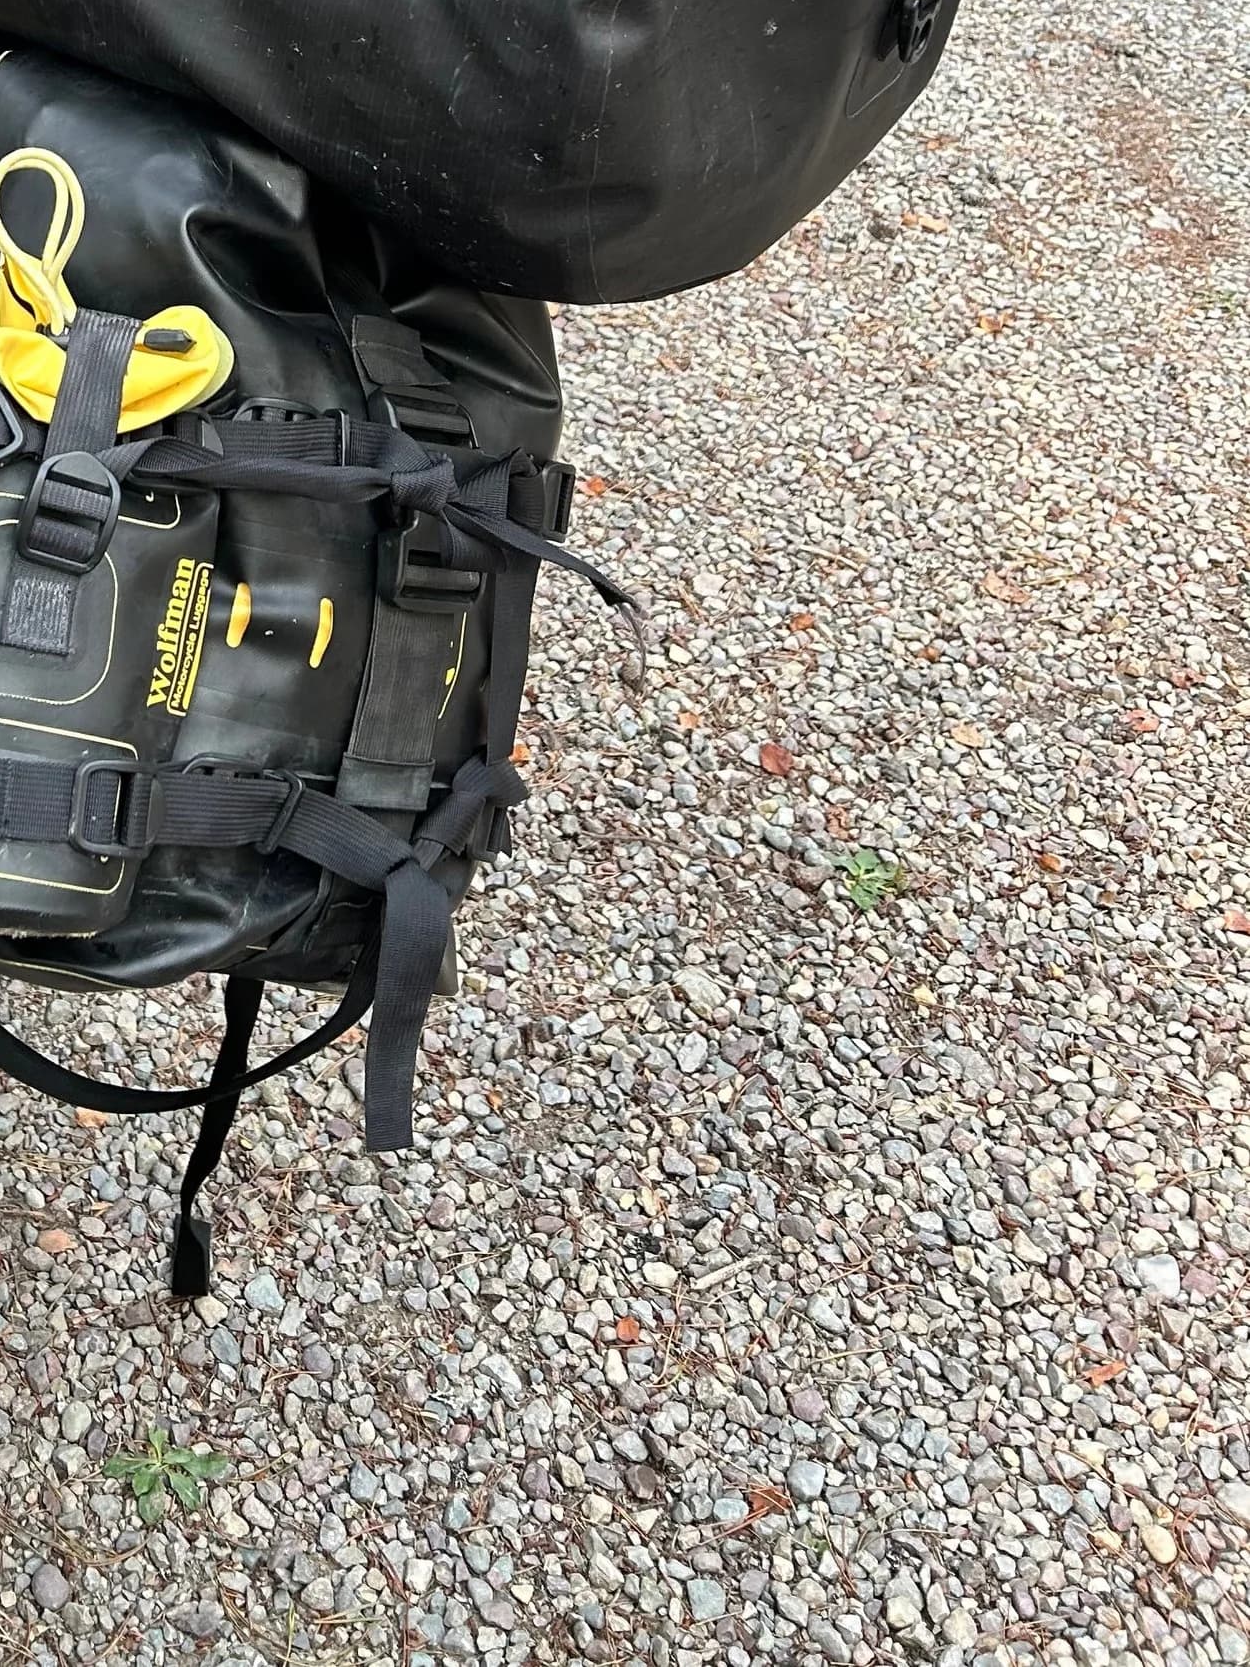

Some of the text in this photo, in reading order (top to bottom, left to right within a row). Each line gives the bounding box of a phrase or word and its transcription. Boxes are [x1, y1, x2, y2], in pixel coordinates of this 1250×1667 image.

[146, 557, 196, 708] Wolfman
[170, 568, 210, 708] Motorcycle Luggage
